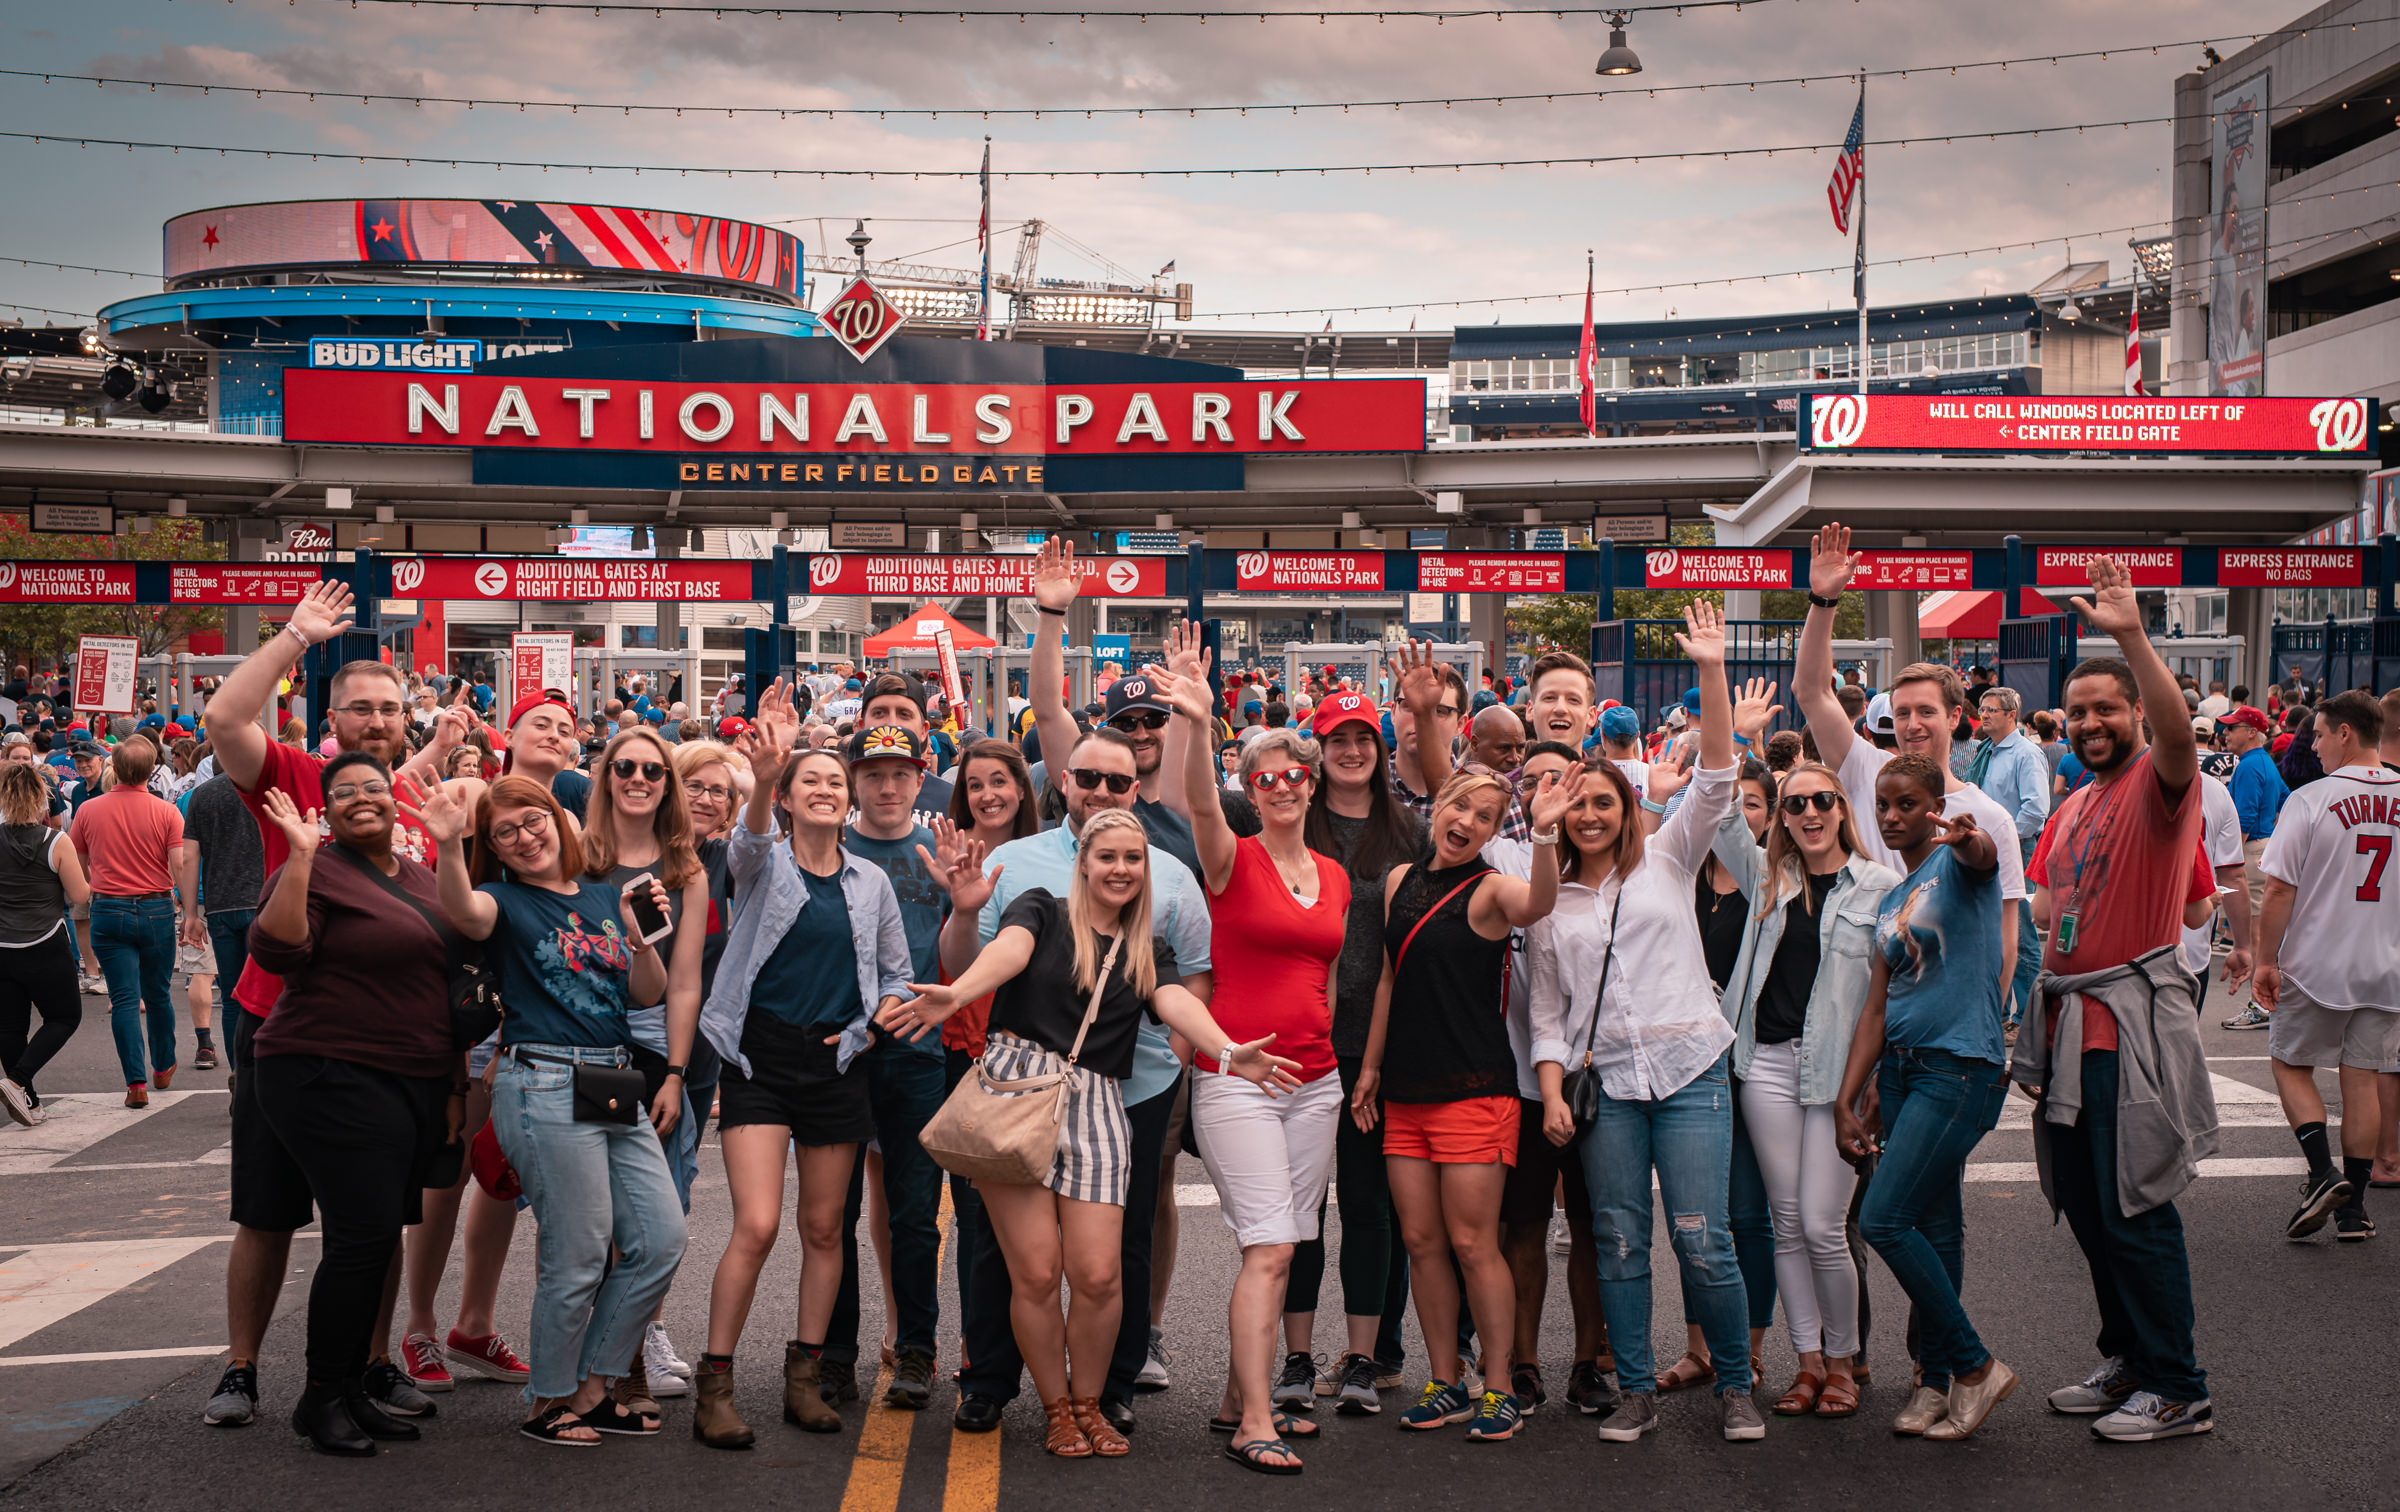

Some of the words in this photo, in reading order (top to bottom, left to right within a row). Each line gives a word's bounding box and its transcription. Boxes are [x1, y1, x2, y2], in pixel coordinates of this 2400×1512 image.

[315, 343, 380, 366] BUD
[385, 341, 476, 367] LIGHT
[405, 380, 1015, 447] NATIONALS
[1054, 388, 1308, 446] PARK
[1930, 403, 1969, 419] WILL
[1974, 403, 2015, 420] CALL
[2019, 403, 2098, 421] WINDOWS
[2102, 403, 2176, 421] LOCATED
[2180, 404, 2220, 421] LEFT
[2225, 404, 2245, 421] OF
[2018, 425, 2081, 441] CENTER
[2085, 425, 2133, 441] FIELD
[2138, 425, 2181, 441] GATE
[679, 462, 828, 485] CENTER
[833, 462, 942, 485] FIELD
[952, 462, 1046, 485] GATE
[1273, 558, 1335, 570] WELCOME
[1339, 558, 1354, 570] TO
[1422, 558, 1445, 566] METAL
[1682, 556, 1744, 570] WELCOME
[1748, 556, 1763, 568] TO
[2043, 552, 2101, 567] EXPRES
[2225, 554, 2282, 567] EXPRESS
[2286, 554, 2354, 568] ENTRANCE
[174, 568, 198, 577] METAL
[516, 563, 600, 579] ADDITIONAL
[605, 563, 647, 579] GATES
[651, 564, 667, 579] AT
[866, 559, 948, 574] ADDITIONAL
[953, 559, 995, 574] GATES
[1000, 559, 1016, 574] AT
[1422, 568, 1464, 576] DETECTORS
[21, 569, 85, 581] WELCOME
[89, 569, 105, 581] TO
[1274, 571, 1341, 584] NATIONALS
[1346, 572, 1378, 584] PARK
[1683, 569, 1749, 582] NATIONALS
[1754, 569, 1787, 582] PARK
[2267, 569, 2280, 580] NO
[2285, 569, 2311, 580] BAGS
[174, 578, 217, 587] DETECTORS
[866, 576, 908, 592] THIRD
[913, 576, 948, 592] BASE
[952, 577, 980, 592] AND
[985, 577, 1024, 592] HOME
[1422, 578, 1447, 586] IN-USE
[22, 583, 91, 595] NATIONALS
[96, 583, 130, 595] PARK
[174, 589, 200, 598] IN-USE
[517, 581, 559, 597] RIGHT
[563, 581, 603, 597] FIELD
[608, 581, 636, 597] AND
[641, 581, 681, 597] FIRST
[686, 581, 720, 597] BASE
[1096, 647, 1125, 658] LOFT
[2355, 833, 2392, 902] 7
